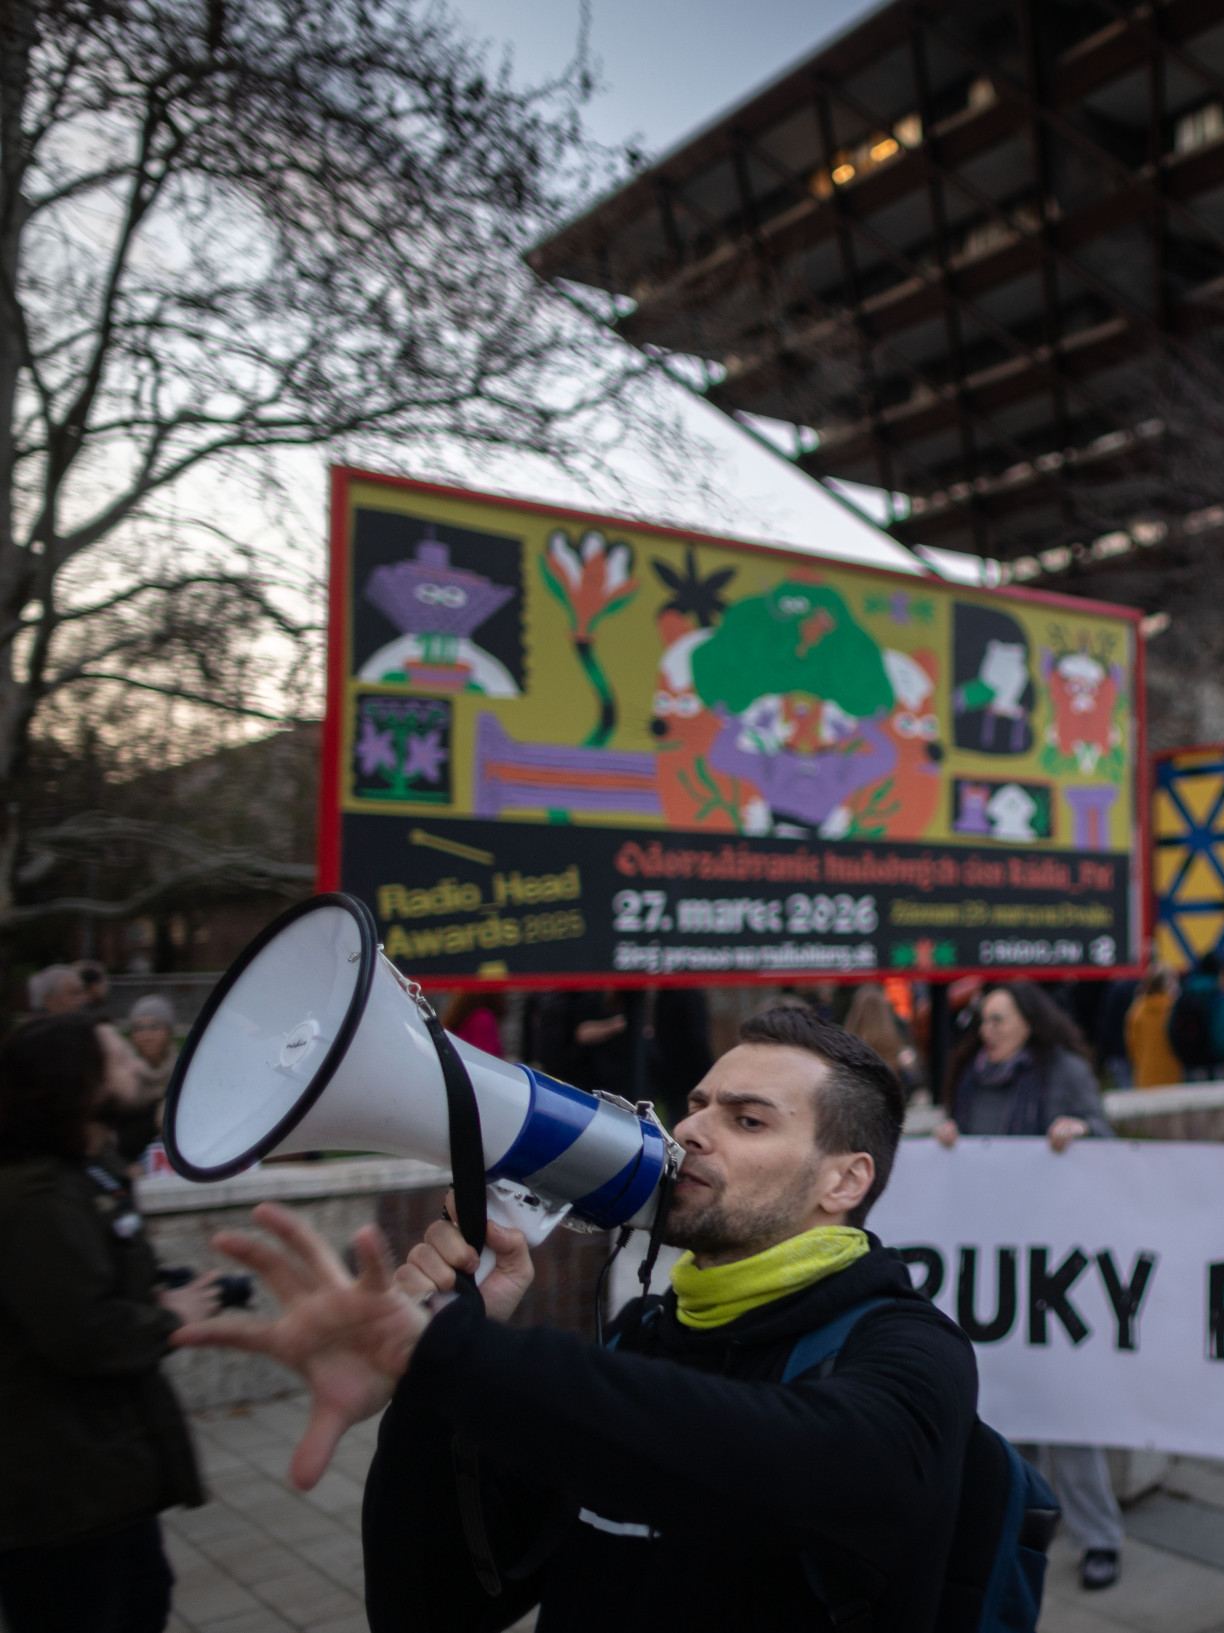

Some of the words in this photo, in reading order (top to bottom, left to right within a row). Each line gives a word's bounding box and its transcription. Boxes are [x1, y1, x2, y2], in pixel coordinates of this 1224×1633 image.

[612, 889, 674, 933] 27.
[676, 897, 783, 934] marec
[785, 893, 879, 934] 2026
[385, 911, 521, 960] Awards
